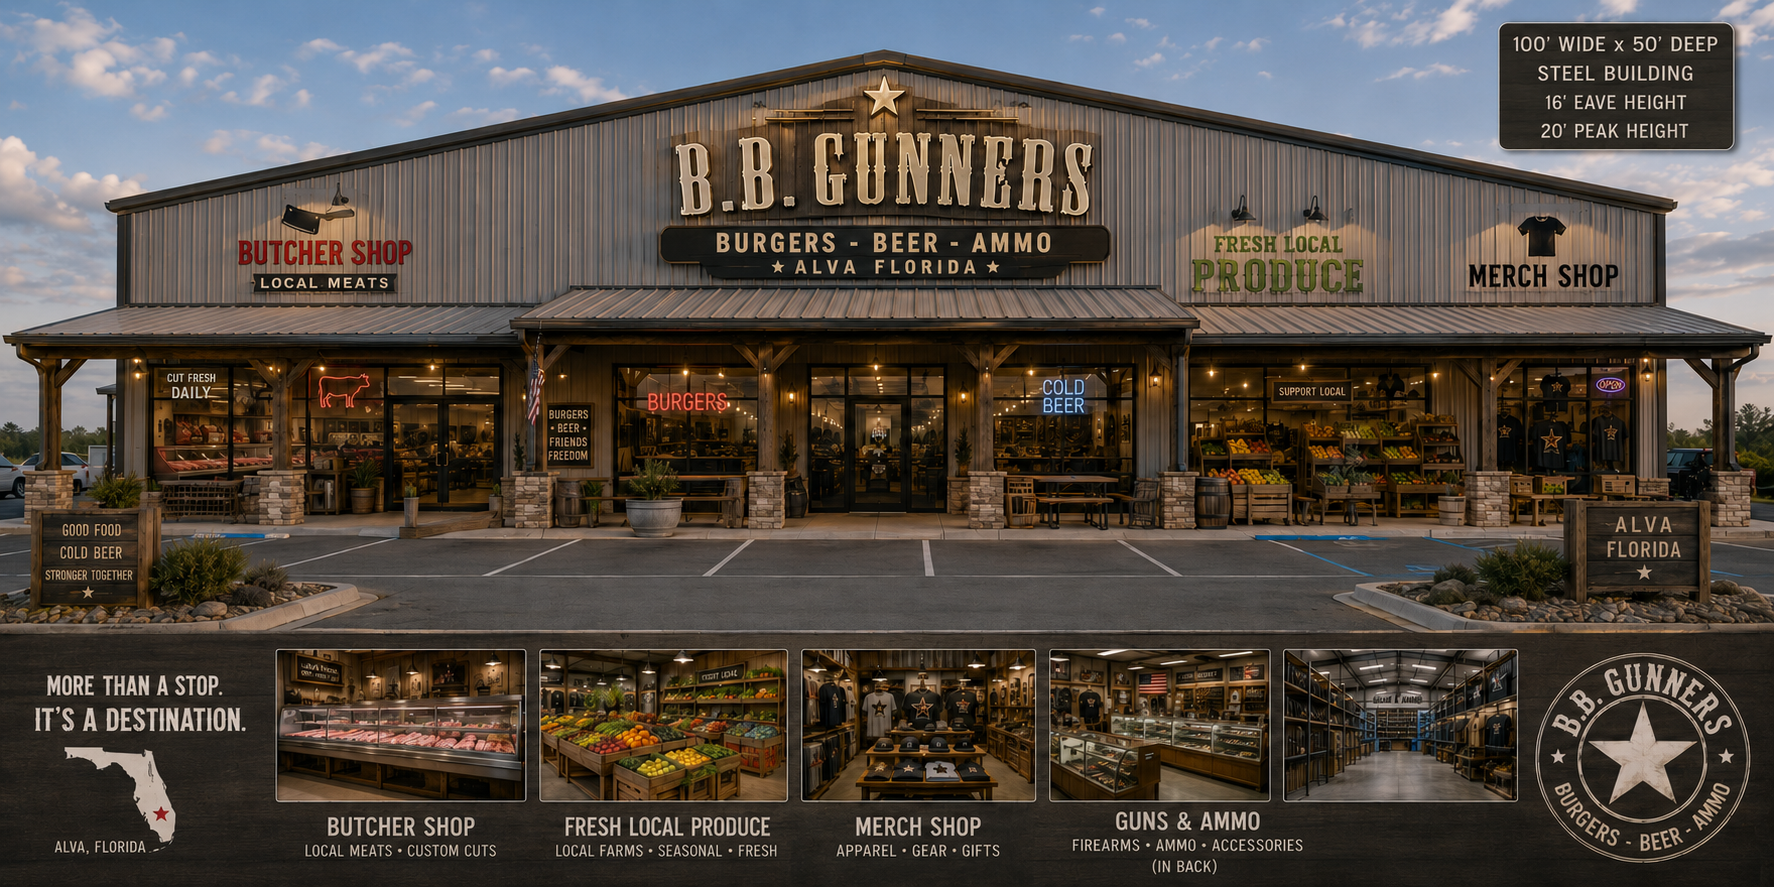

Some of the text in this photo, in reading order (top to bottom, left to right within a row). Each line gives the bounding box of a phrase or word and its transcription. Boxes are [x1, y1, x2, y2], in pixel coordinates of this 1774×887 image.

[676, 132, 1094, 216] B.B. GUNNERS
[717, 233, 835, 253] BURGERS
[874, 233, 937, 252] BEER
[972, 233, 1050, 253] AMMO
[1214, 236, 1343, 253] FRESH LOCAL
[239, 240, 411, 264] BUTCHER SHOP
[795, 260, 975, 274] ALVA FLORIDA
[1192, 258, 1363, 292] PRODUCE
[1469, 264, 1618, 288] MERCH SHOP
[261, 277, 388, 288] LOCAL MEATS
[167, 373, 215, 383] CUT FRESH
[172, 386, 212, 398] DAILY
[1043, 380, 1084, 395] COLD
[1279, 386, 1345, 396] SUPPORT LOCAL
[648, 393, 728, 412] BURGERS
[1044, 398, 1084, 413] BEER
[549, 409, 588, 419] BURGERS
[558, 422, 579, 432] BEER
[550, 436, 587, 447] FRIENDS
[548, 451, 588, 461] FREEDOM
[63, 524, 121, 536] GOOD FOOD
[1615, 516, 1672, 532] ALVA
[60, 546, 122, 559] COLD BEER
[1608, 541, 1680, 557] FLORIDA
[46, 569, 132, 580] STRONGER TOGETHER
